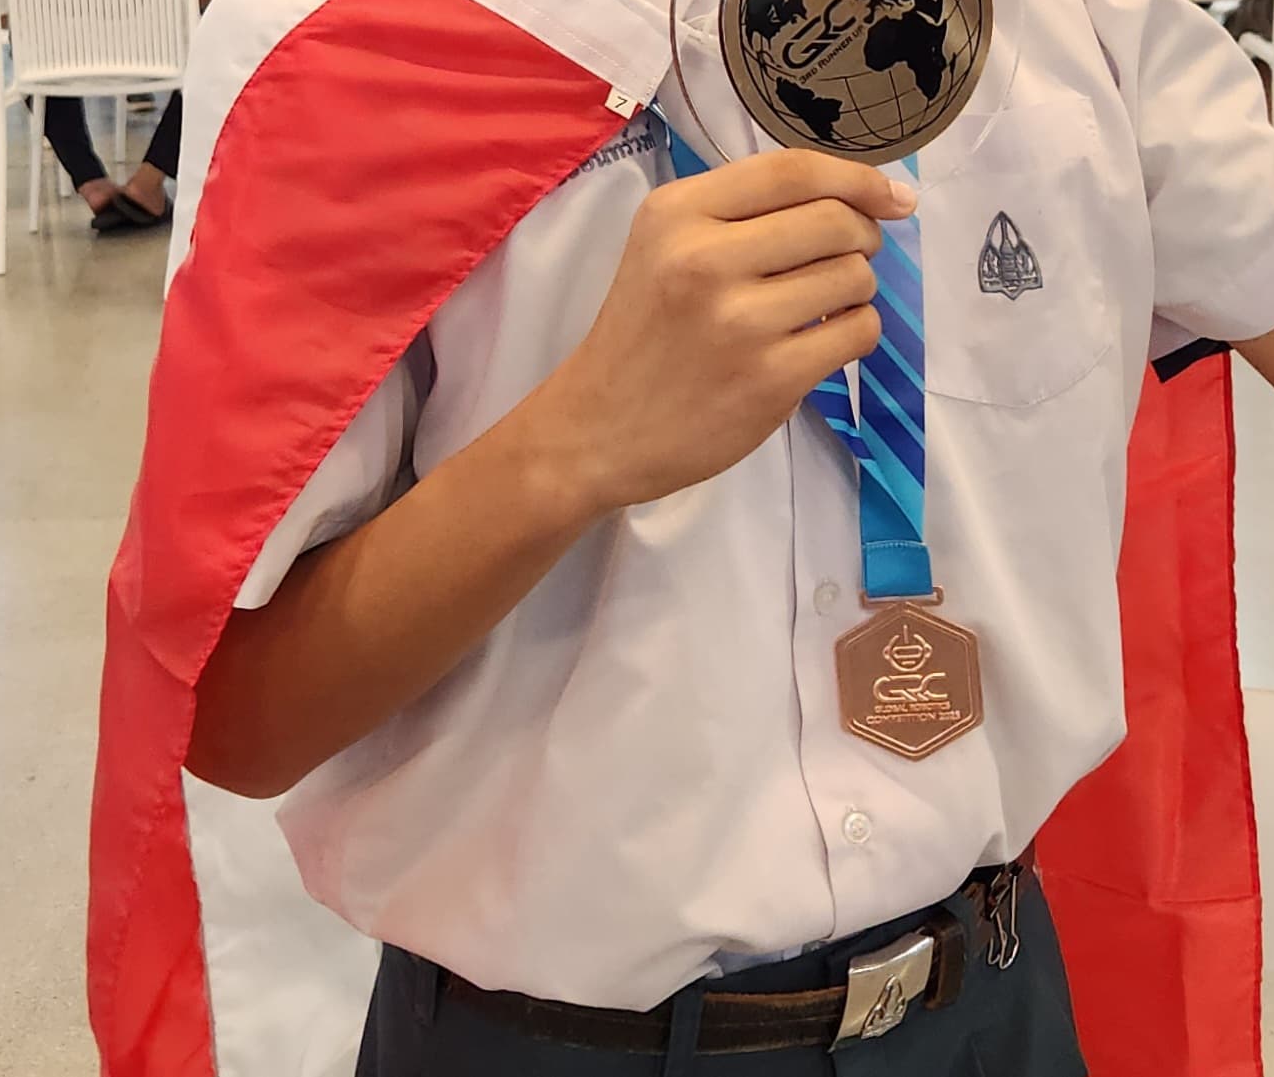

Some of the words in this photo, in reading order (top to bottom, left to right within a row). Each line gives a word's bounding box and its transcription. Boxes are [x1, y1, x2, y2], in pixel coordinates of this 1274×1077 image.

[799, 66, 818, 84] 3RD
[818, 35, 853, 70] RUNNER
[852, 24, 865, 38] UP
[873, 672, 948, 702] GRC
